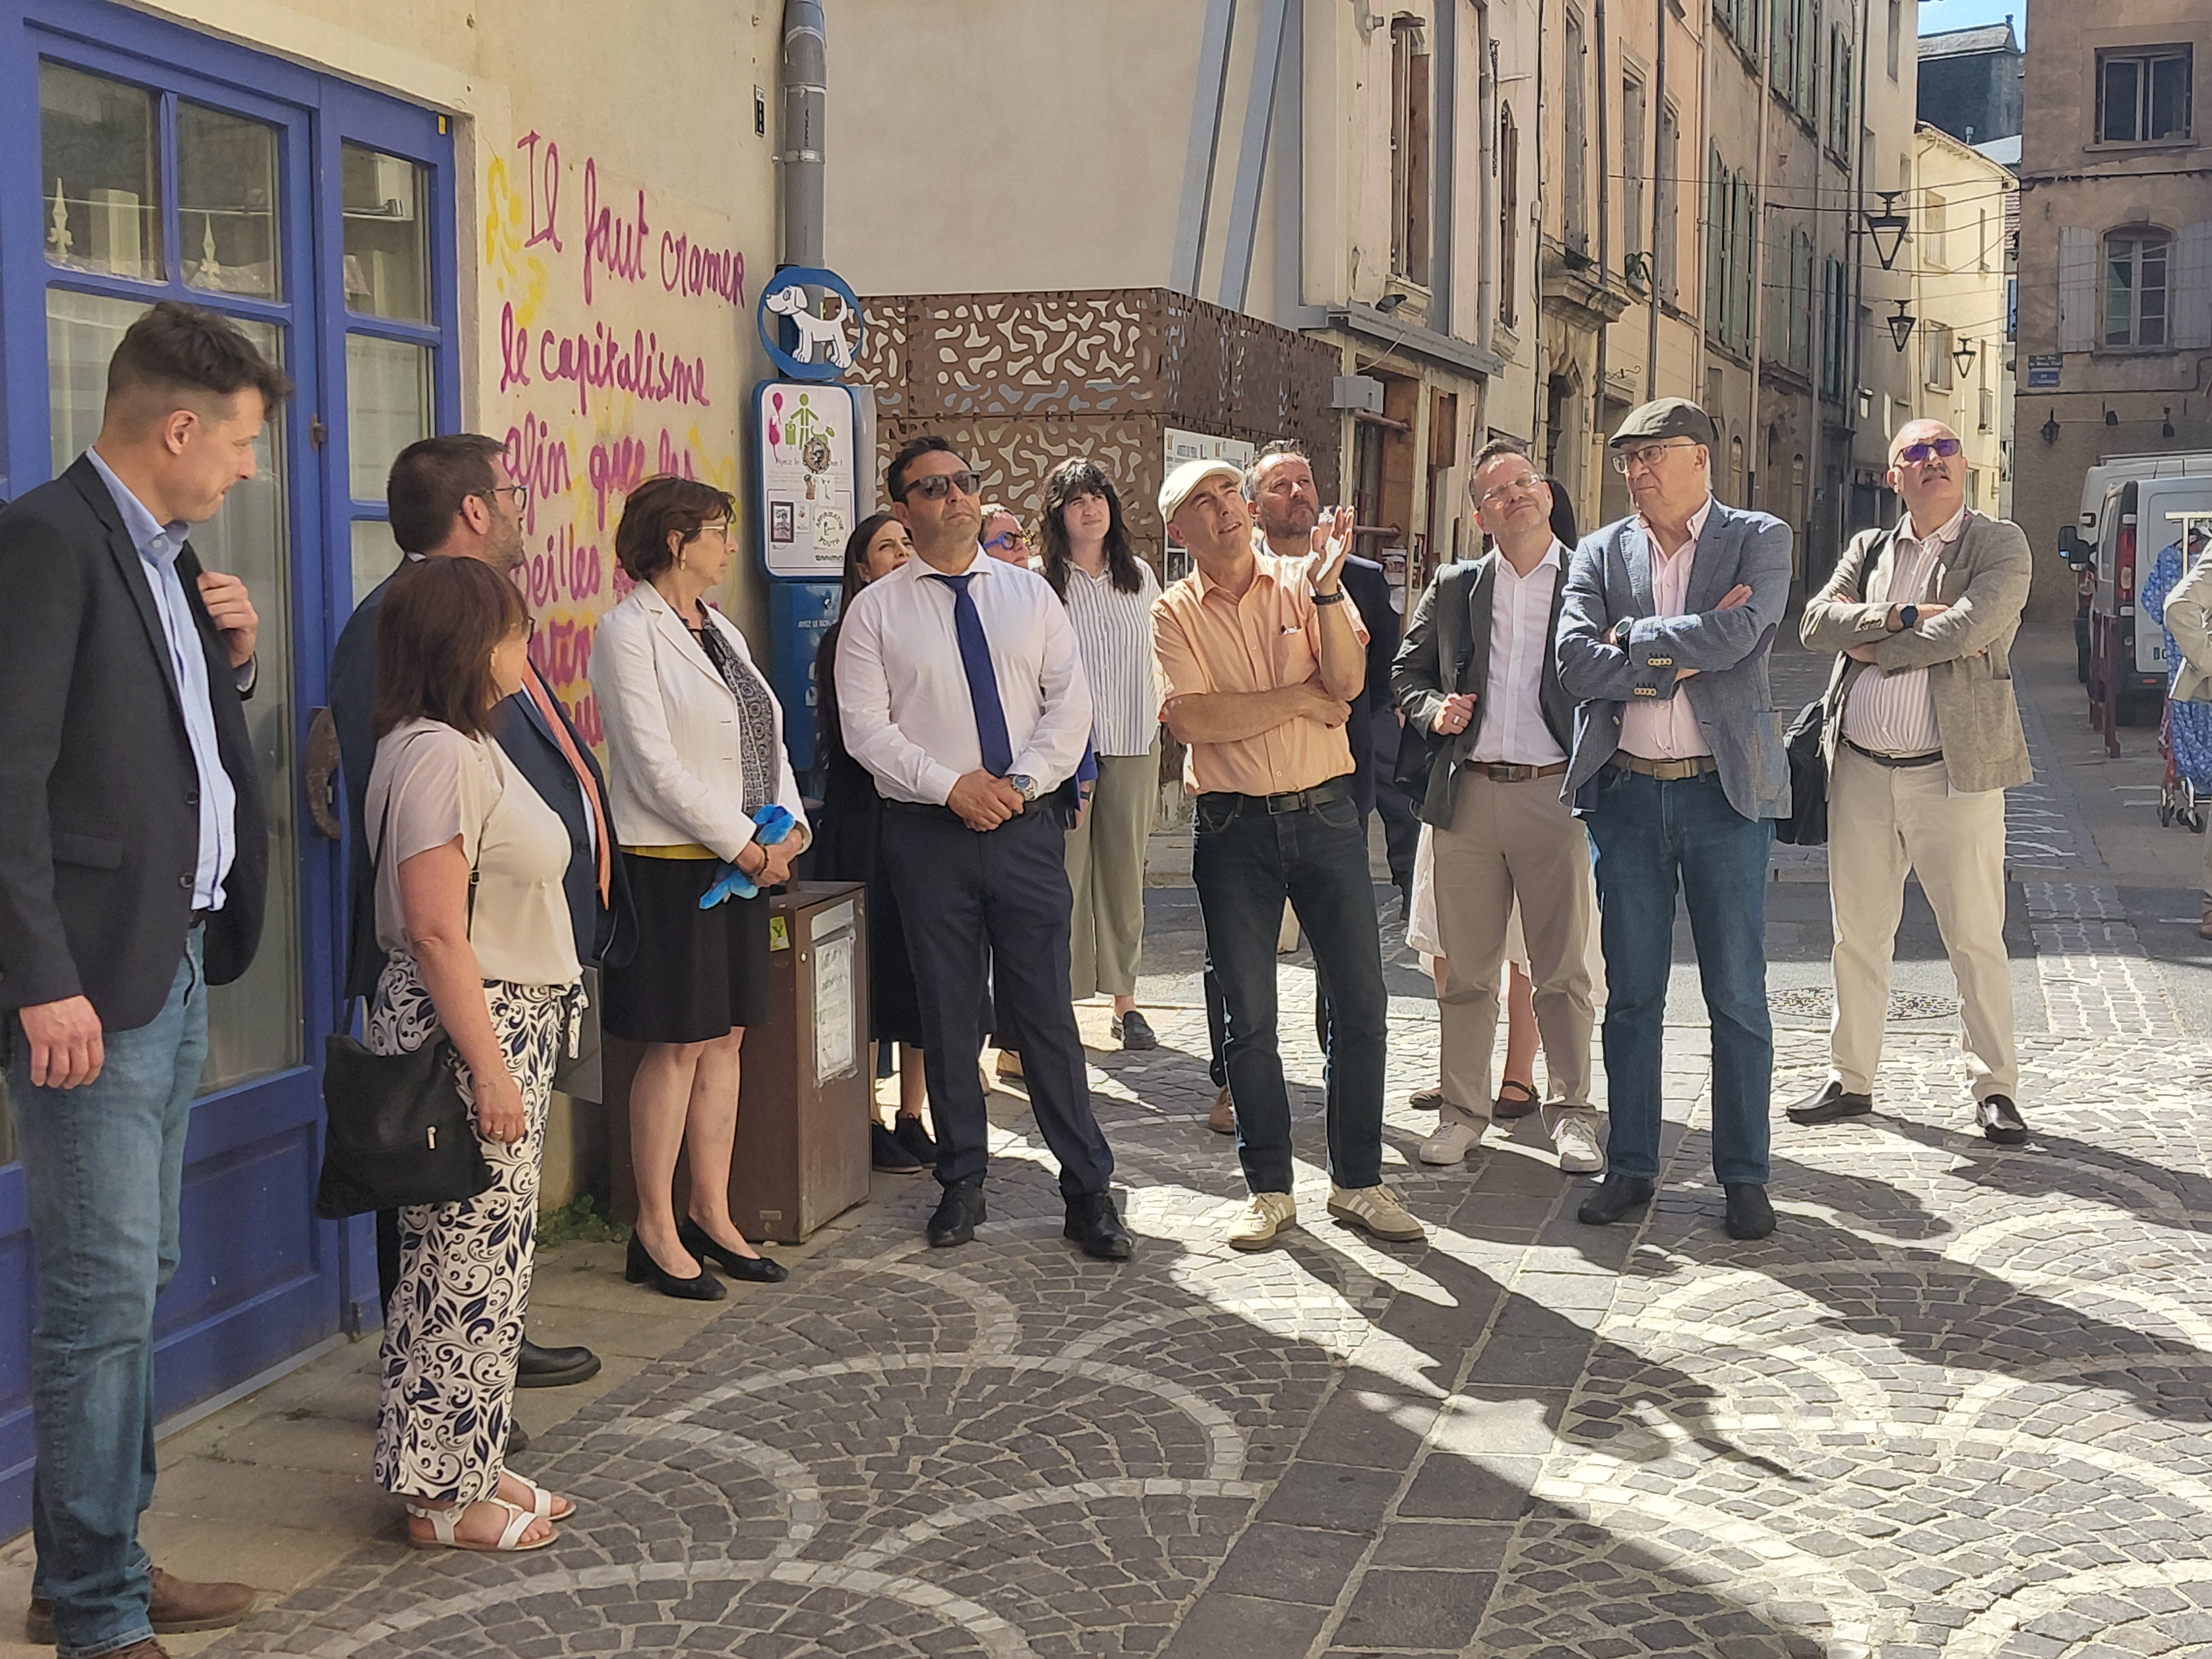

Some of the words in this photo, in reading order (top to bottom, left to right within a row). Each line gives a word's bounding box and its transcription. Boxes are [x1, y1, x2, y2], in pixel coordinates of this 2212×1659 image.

[517, 130, 563, 253] Il
[583, 157, 650, 306] faut
[500, 301, 531, 394] le
[541, 320, 711, 416] capitalisme
[501, 410, 571, 535] afin
